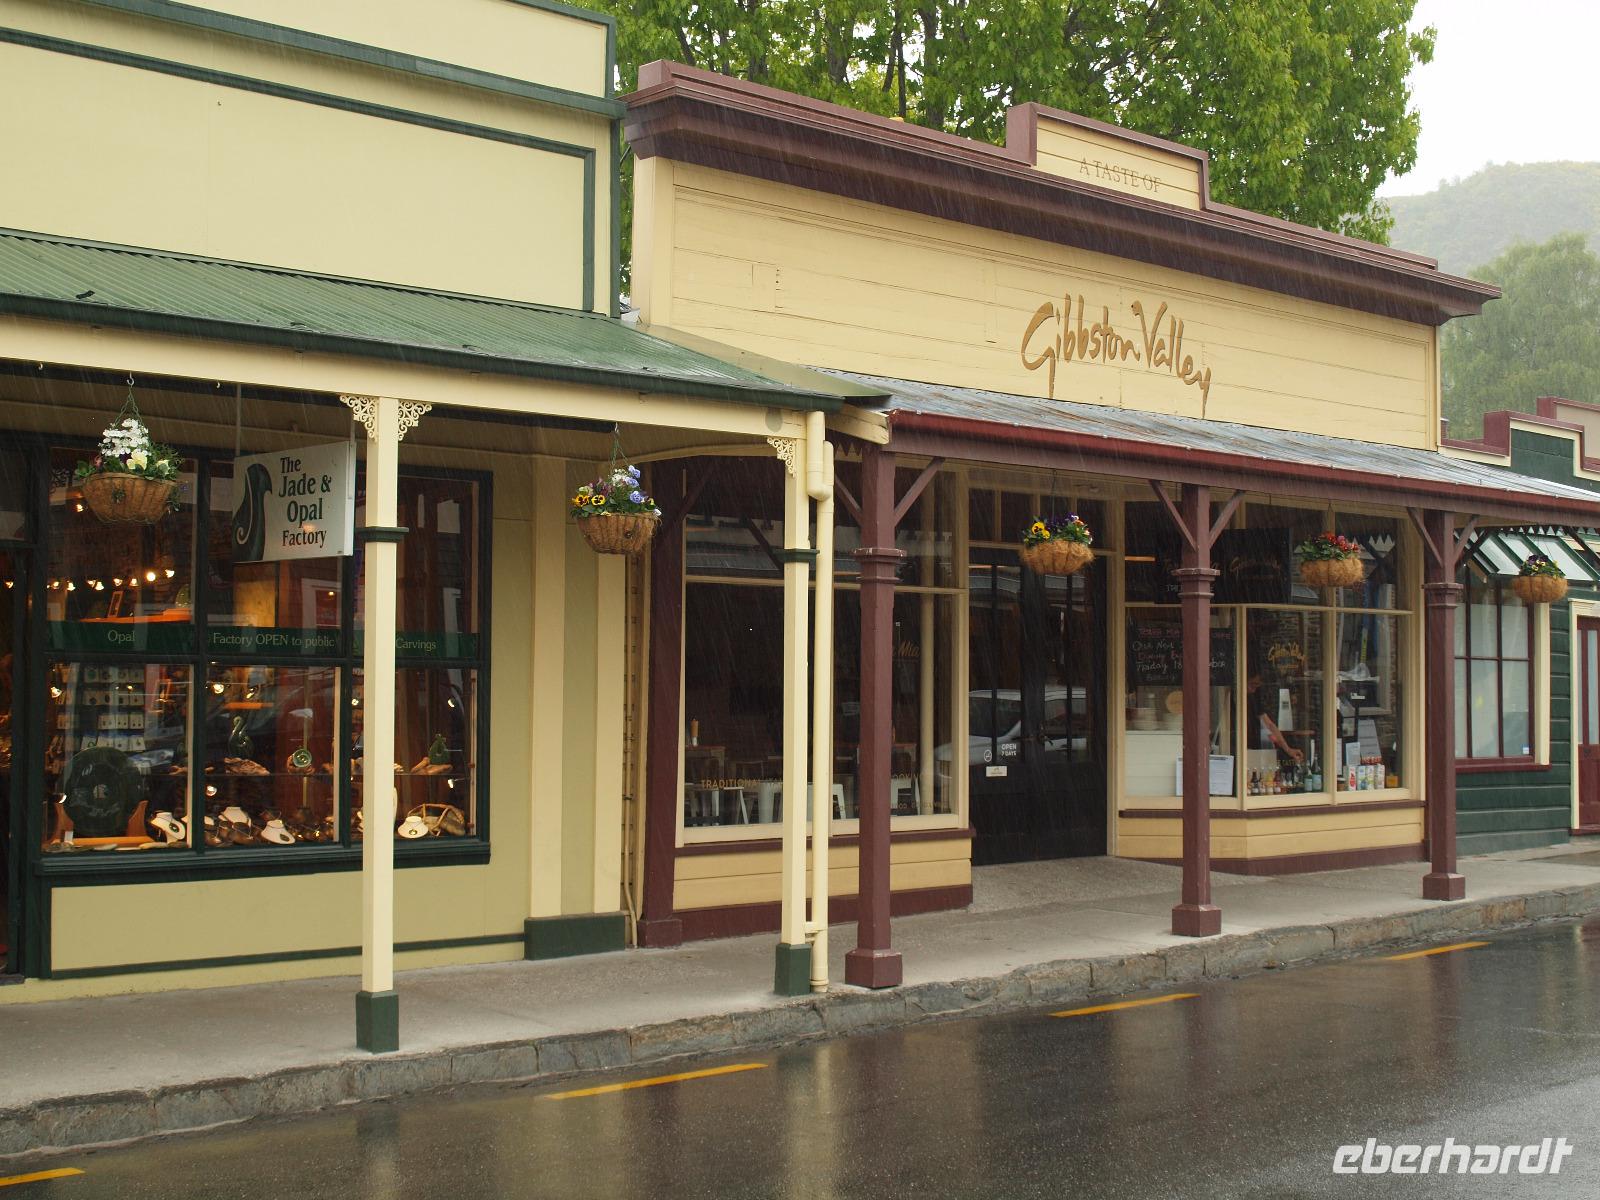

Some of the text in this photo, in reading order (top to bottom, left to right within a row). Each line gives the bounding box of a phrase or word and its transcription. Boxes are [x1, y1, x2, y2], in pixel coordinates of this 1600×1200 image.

[1080, 157, 1160, 192] A TASTE OF
[1021, 293, 1211, 419] Gibbston Valley
[280, 456, 301, 473] The
[279, 473, 332, 498] Jade &
[286, 497, 323, 528] Opal
[282, 530, 327, 549] Factory
[107, 629, 136, 643] Opal
[213, 632, 253, 647] Factory
[255, 633, 288, 646] OPEN
[304, 635, 335, 648] public
[396, 638, 437, 652] Carvings
